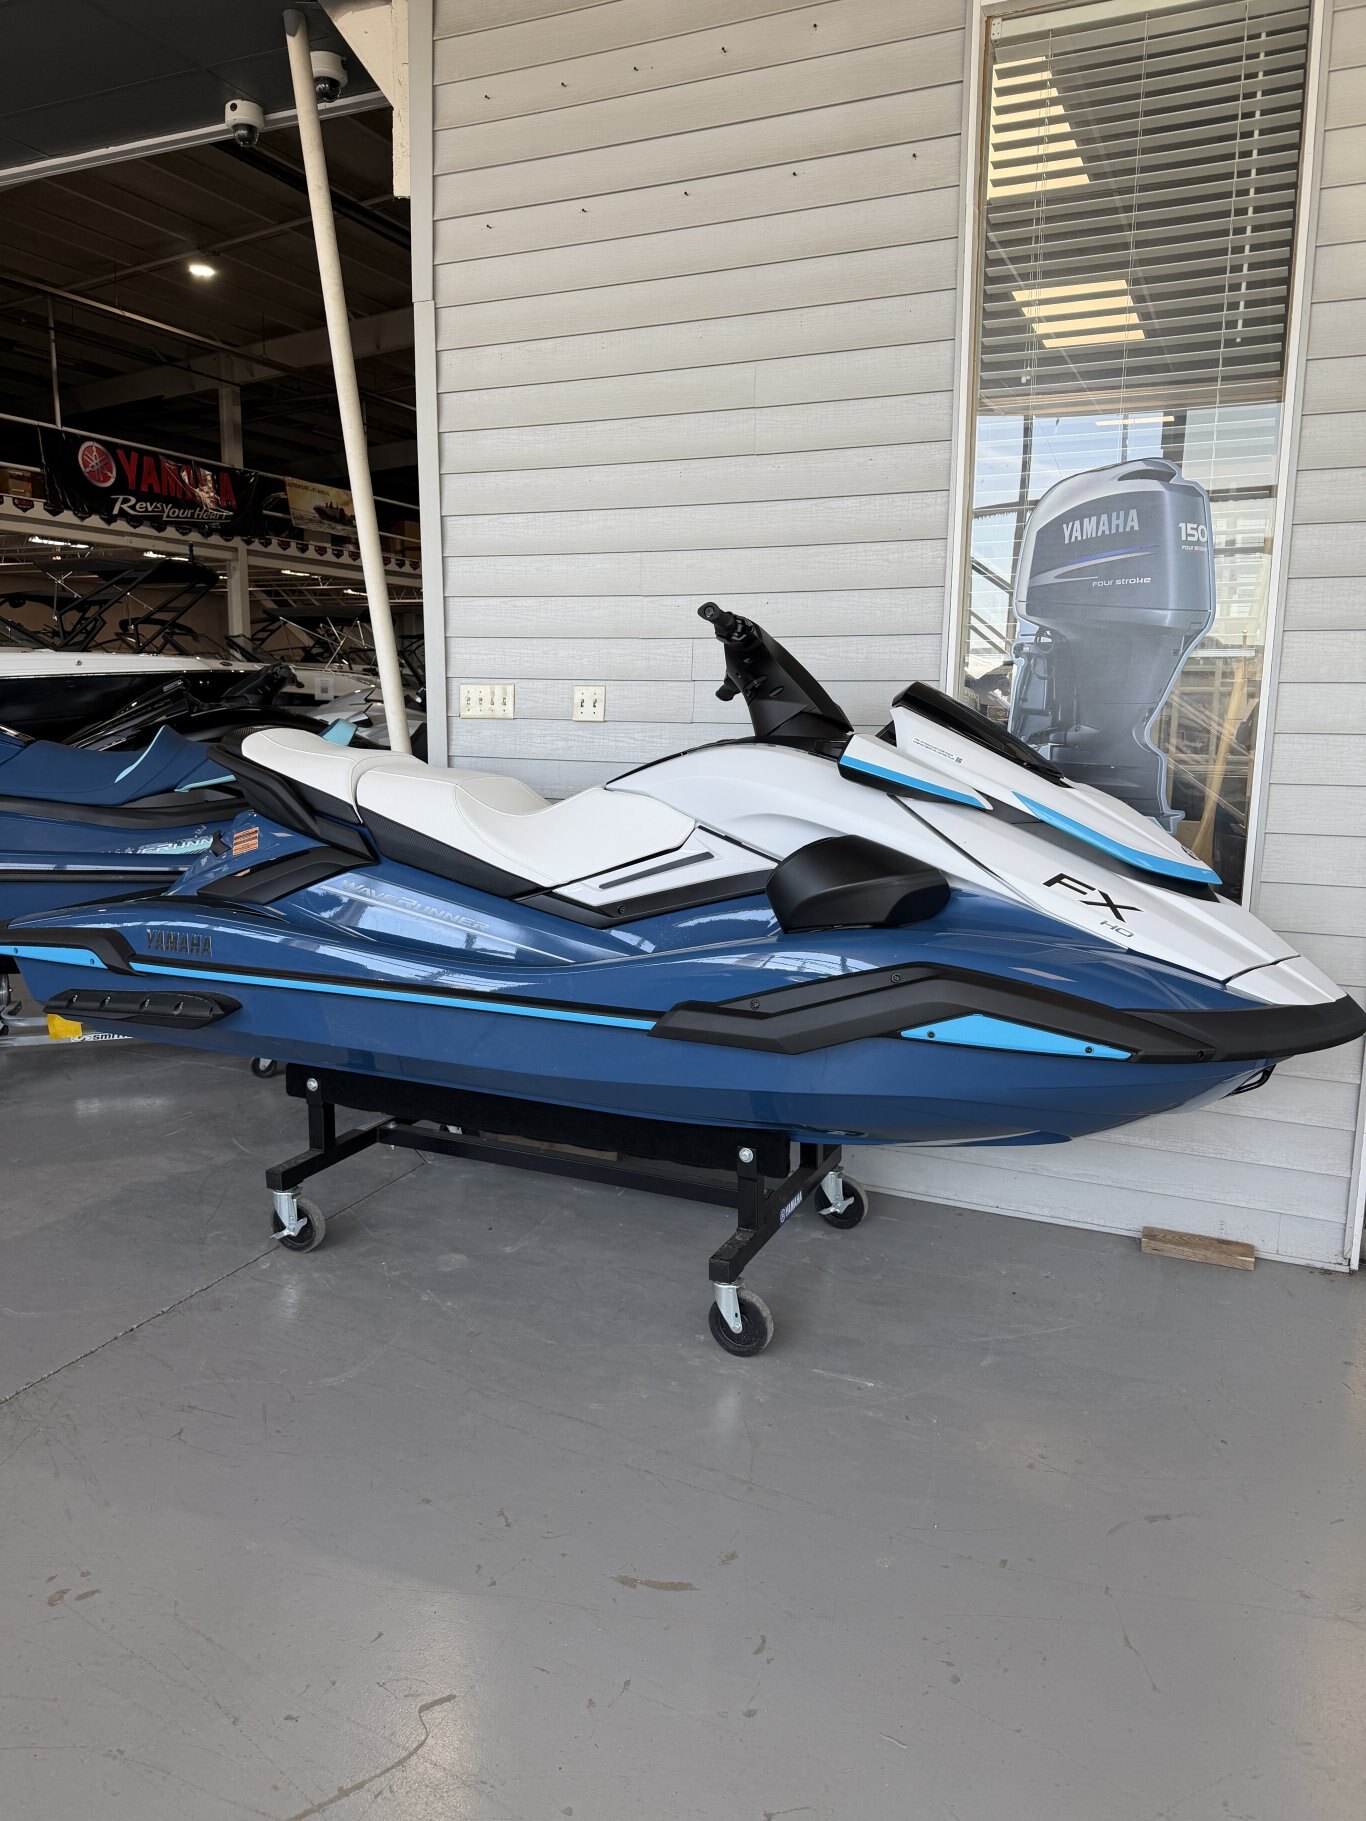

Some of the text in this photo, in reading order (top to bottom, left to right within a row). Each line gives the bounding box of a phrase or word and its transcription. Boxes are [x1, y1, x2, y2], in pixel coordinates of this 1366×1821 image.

[1062, 508, 1140, 545] YAMAHA
[1178, 522, 1208, 543] 150
[1042, 871, 1144, 925] FX
[145, 928, 214, 958] YAMAHA
[1099, 919, 1135, 939] HO
